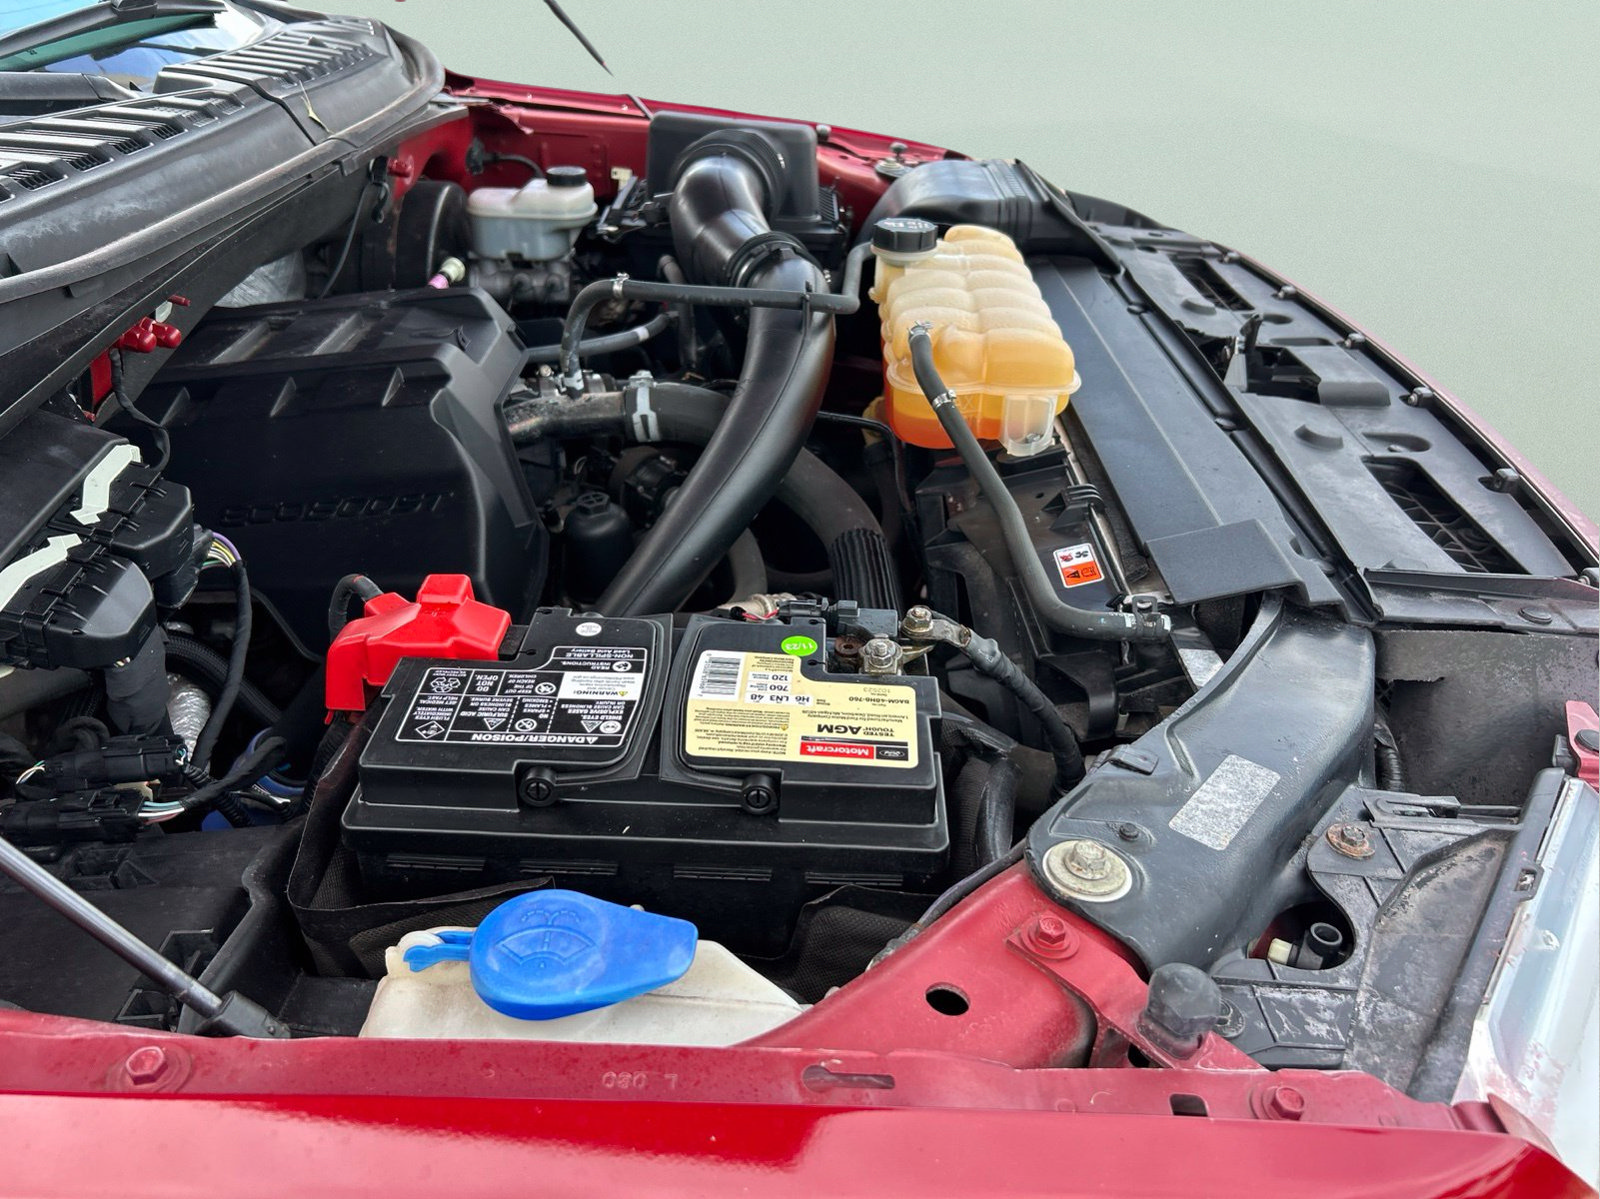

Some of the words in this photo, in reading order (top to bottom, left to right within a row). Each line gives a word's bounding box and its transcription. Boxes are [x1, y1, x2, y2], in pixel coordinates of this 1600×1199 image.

[785, 642, 813, 651] 11/23
[769, 684, 789, 692] 760
[750, 693, 764, 701] 48
[795, 695, 810, 703] H6
[817, 724, 862, 735] AGM
[471, 733, 586, 743] DANGER/POISON
[806, 745, 870, 756] Motorcraft
